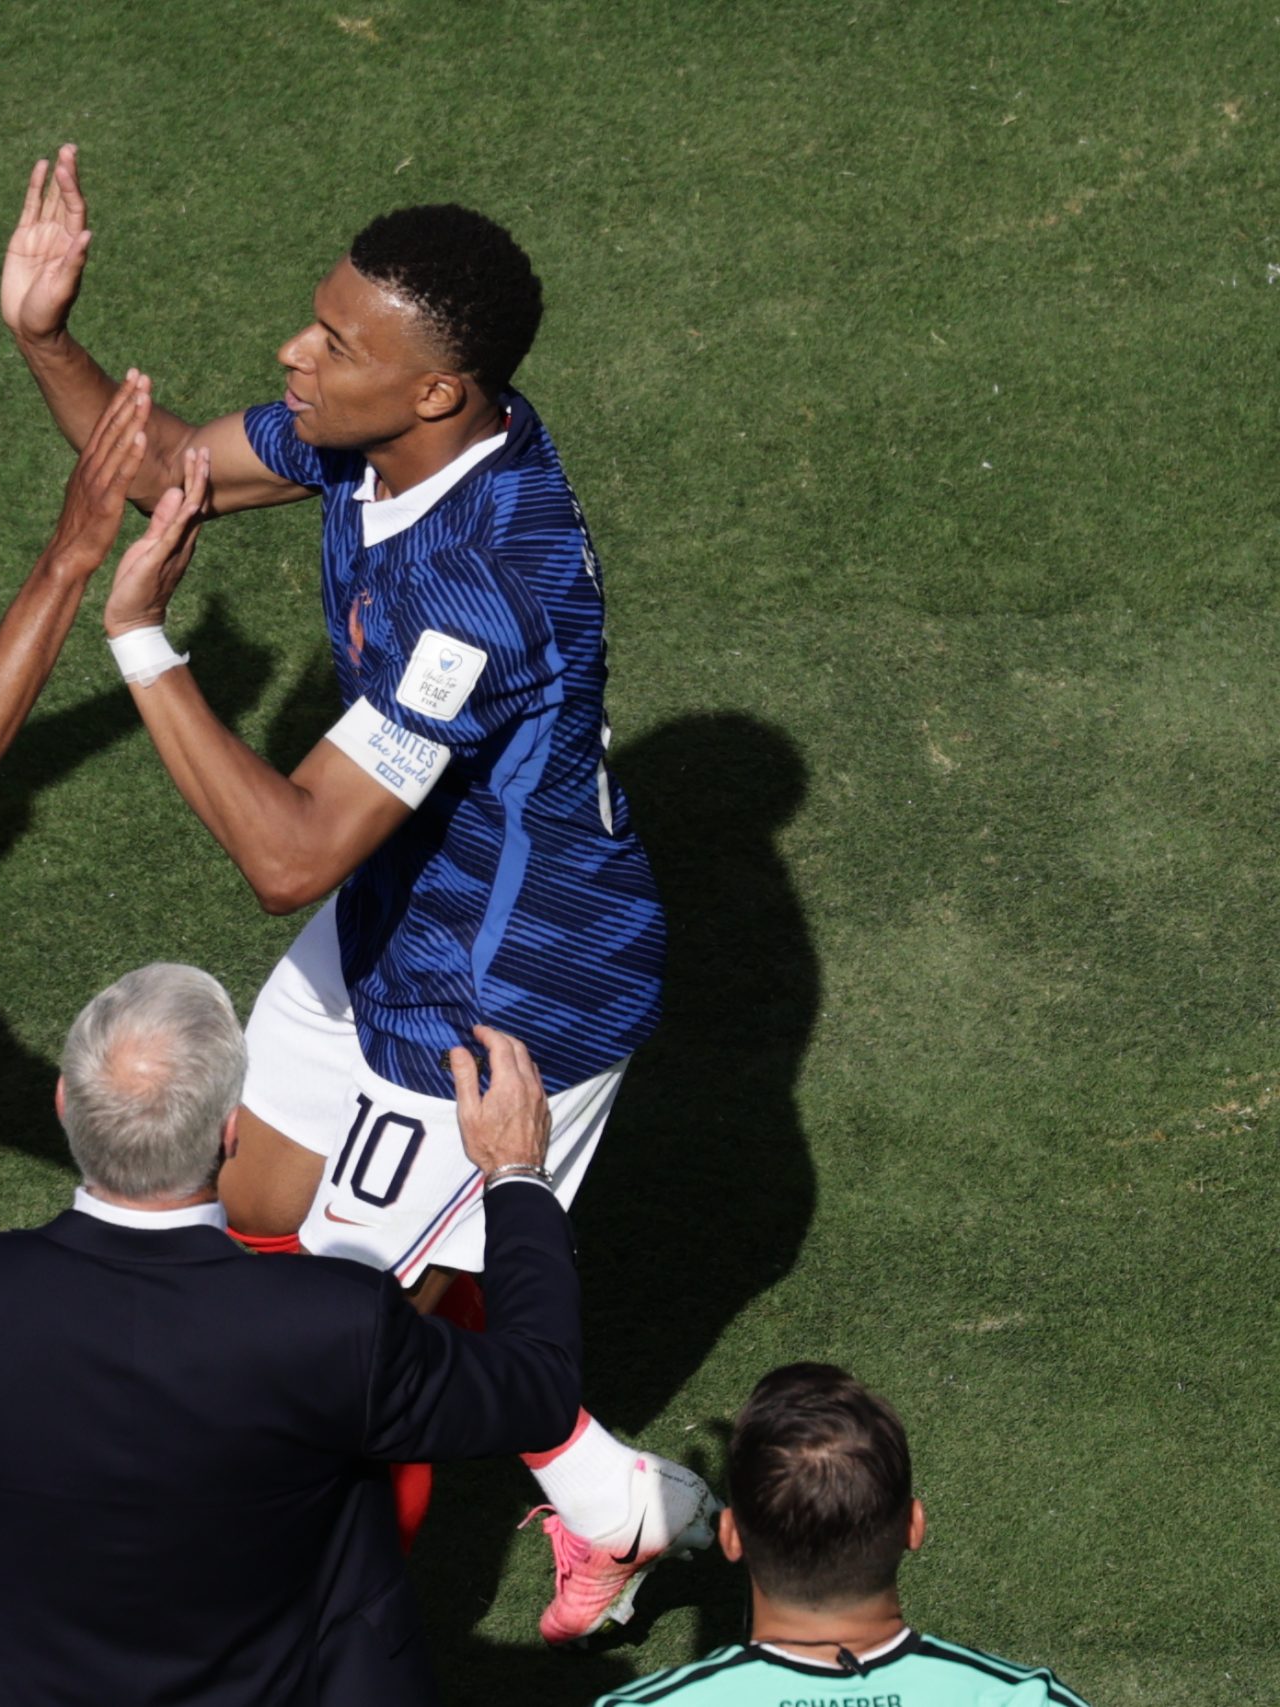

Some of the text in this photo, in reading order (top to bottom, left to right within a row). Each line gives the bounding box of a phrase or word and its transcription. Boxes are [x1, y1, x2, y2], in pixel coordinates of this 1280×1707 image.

[420, 681, 451, 702] PEACE
[368, 732, 432, 787] the World
[380, 719, 438, 768] UNITES
[331, 1092, 426, 1208] 10
